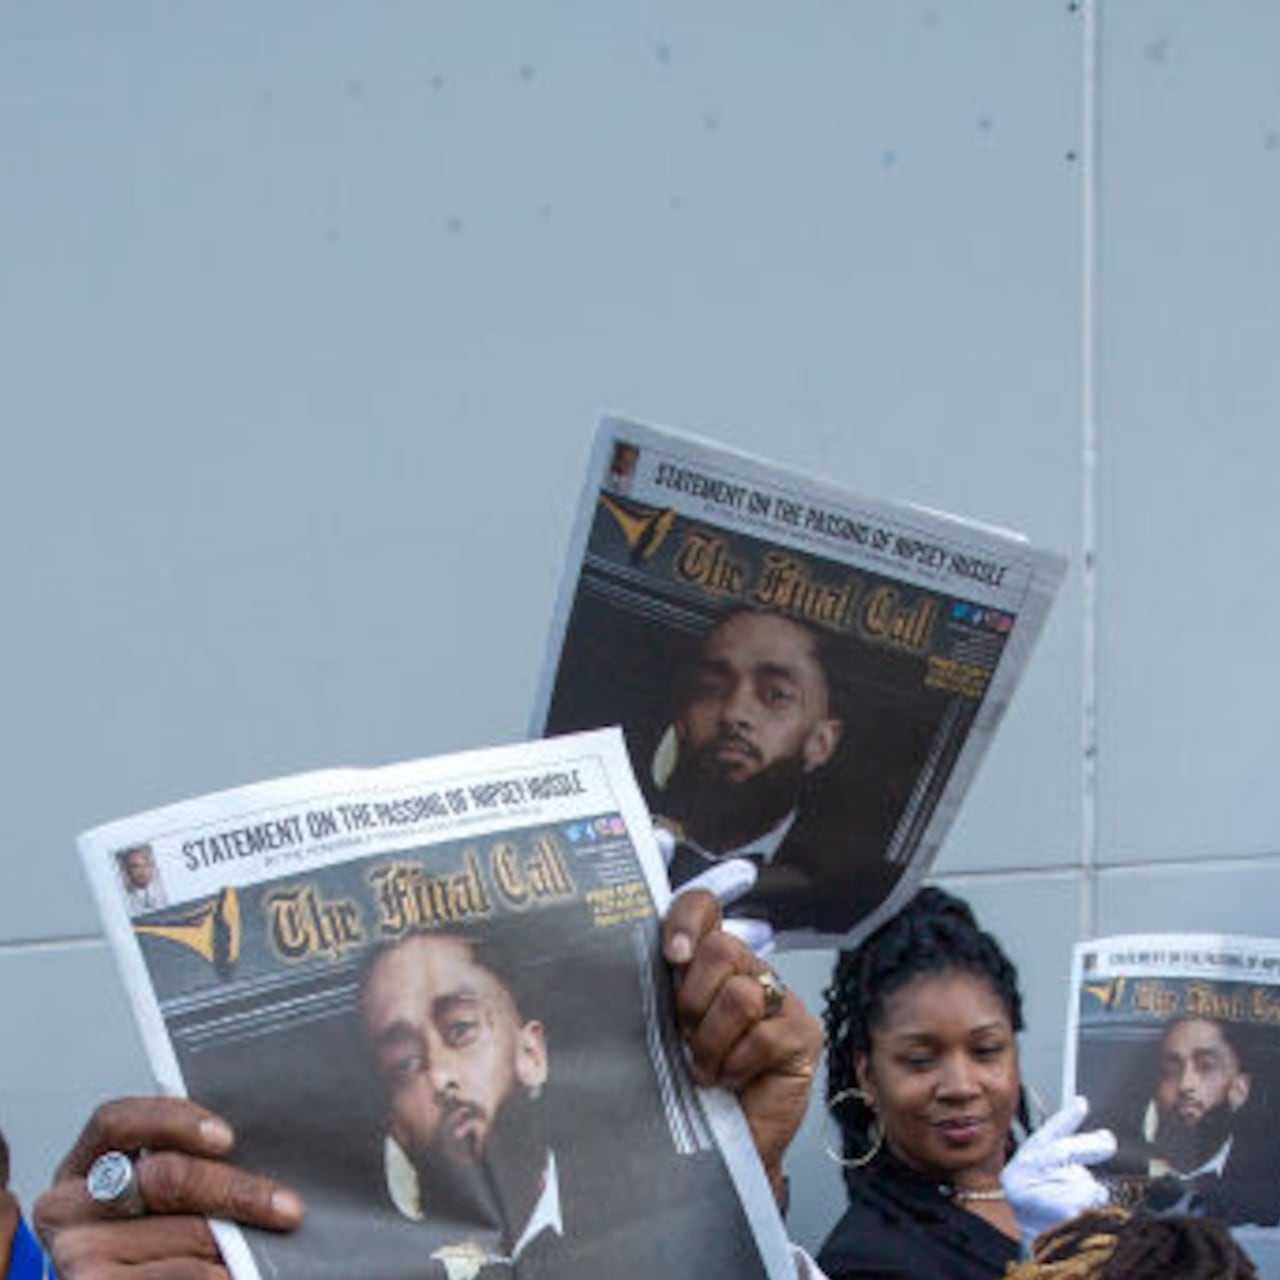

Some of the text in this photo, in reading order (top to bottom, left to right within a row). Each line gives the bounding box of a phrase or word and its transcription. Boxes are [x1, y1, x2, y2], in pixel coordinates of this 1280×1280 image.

[774, 498, 805, 527] THE
[182, 815, 304, 872] STATEMENT
[305, 808, 339, 839] ON
[337, 801, 377, 832] THE
[374, 790, 449, 827] PASSING
[445, 787, 469, 815] OF
[469, 777, 526, 809] NIPSEY
[525, 768, 588, 801] HUSSLE
[268, 886, 362, 960] The
[370, 852, 491, 936] Final
[493, 838, 573, 905] Call
